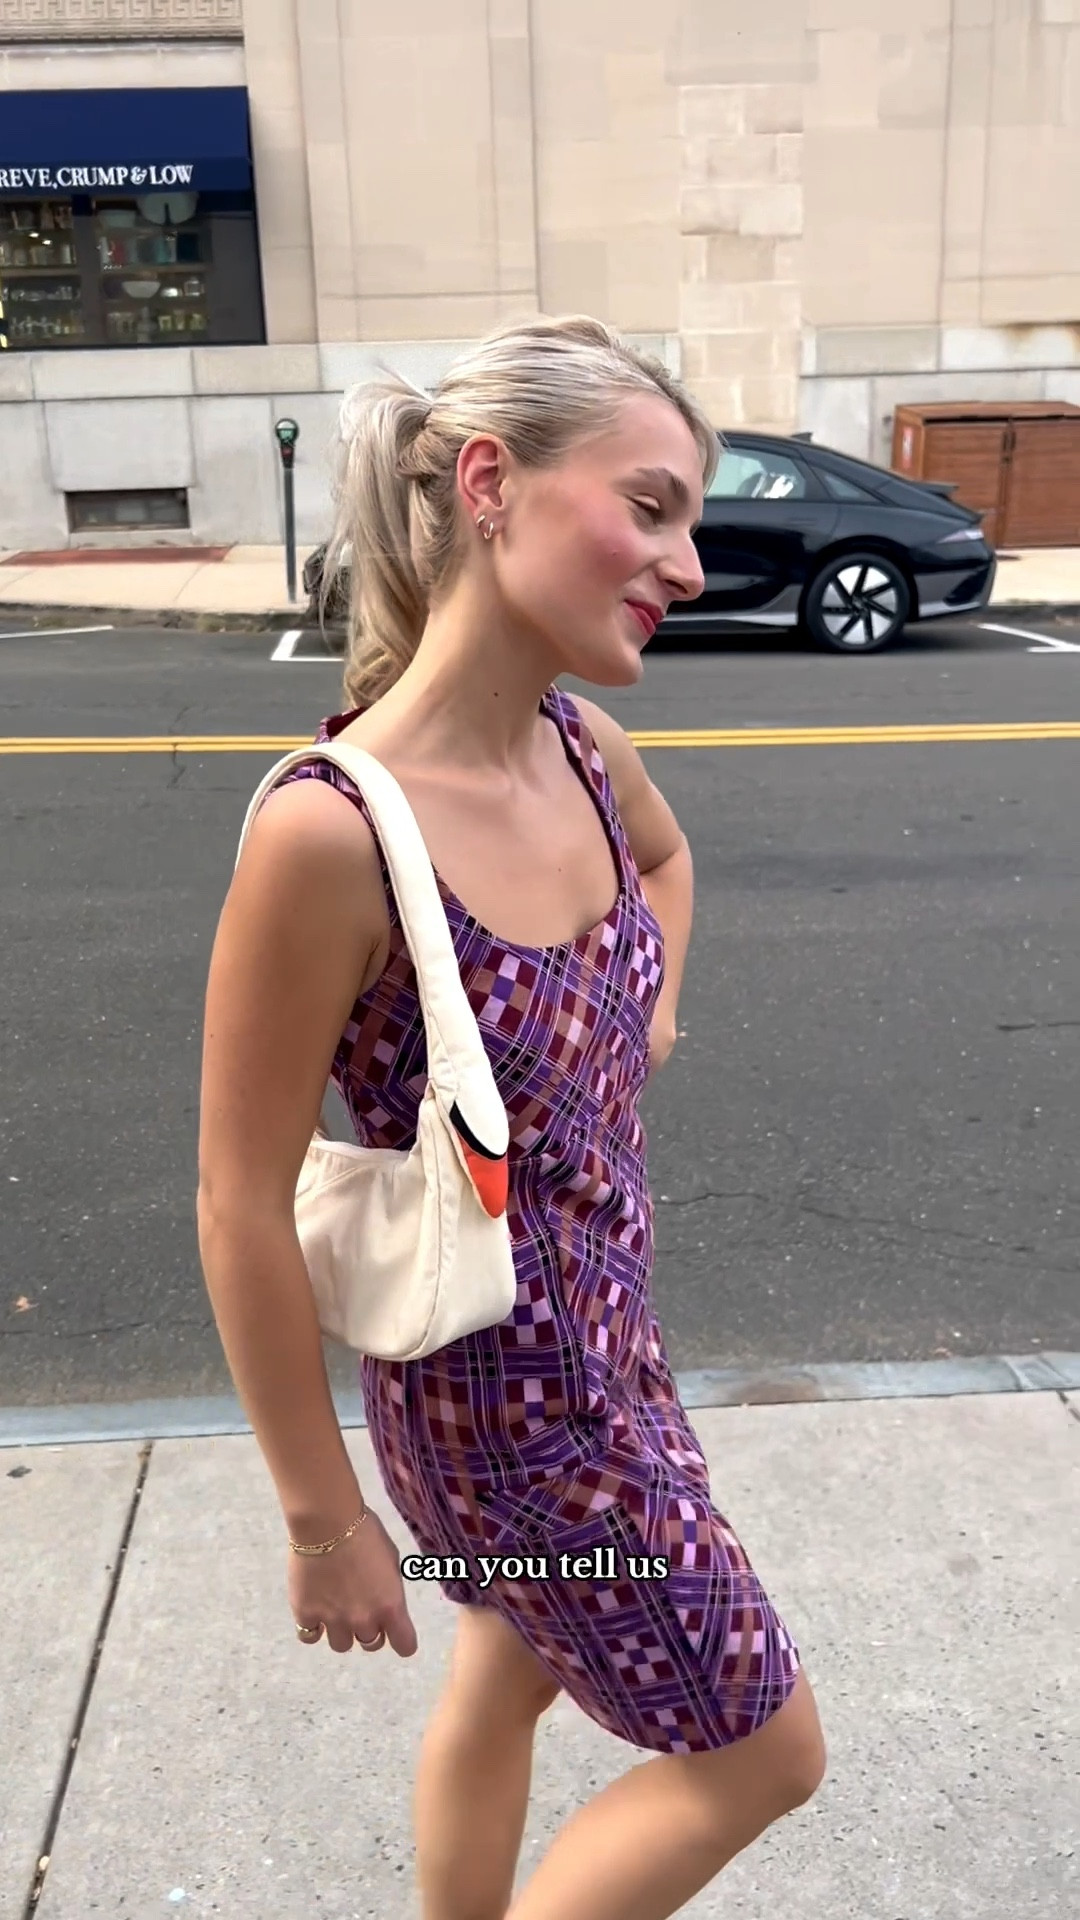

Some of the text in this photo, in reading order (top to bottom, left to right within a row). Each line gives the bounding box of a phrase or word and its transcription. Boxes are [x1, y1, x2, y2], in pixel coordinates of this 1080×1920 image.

[56, 166, 129, 187] CRUMP
[130, 166, 148, 185] &
[149, 165, 193, 185] LOW
